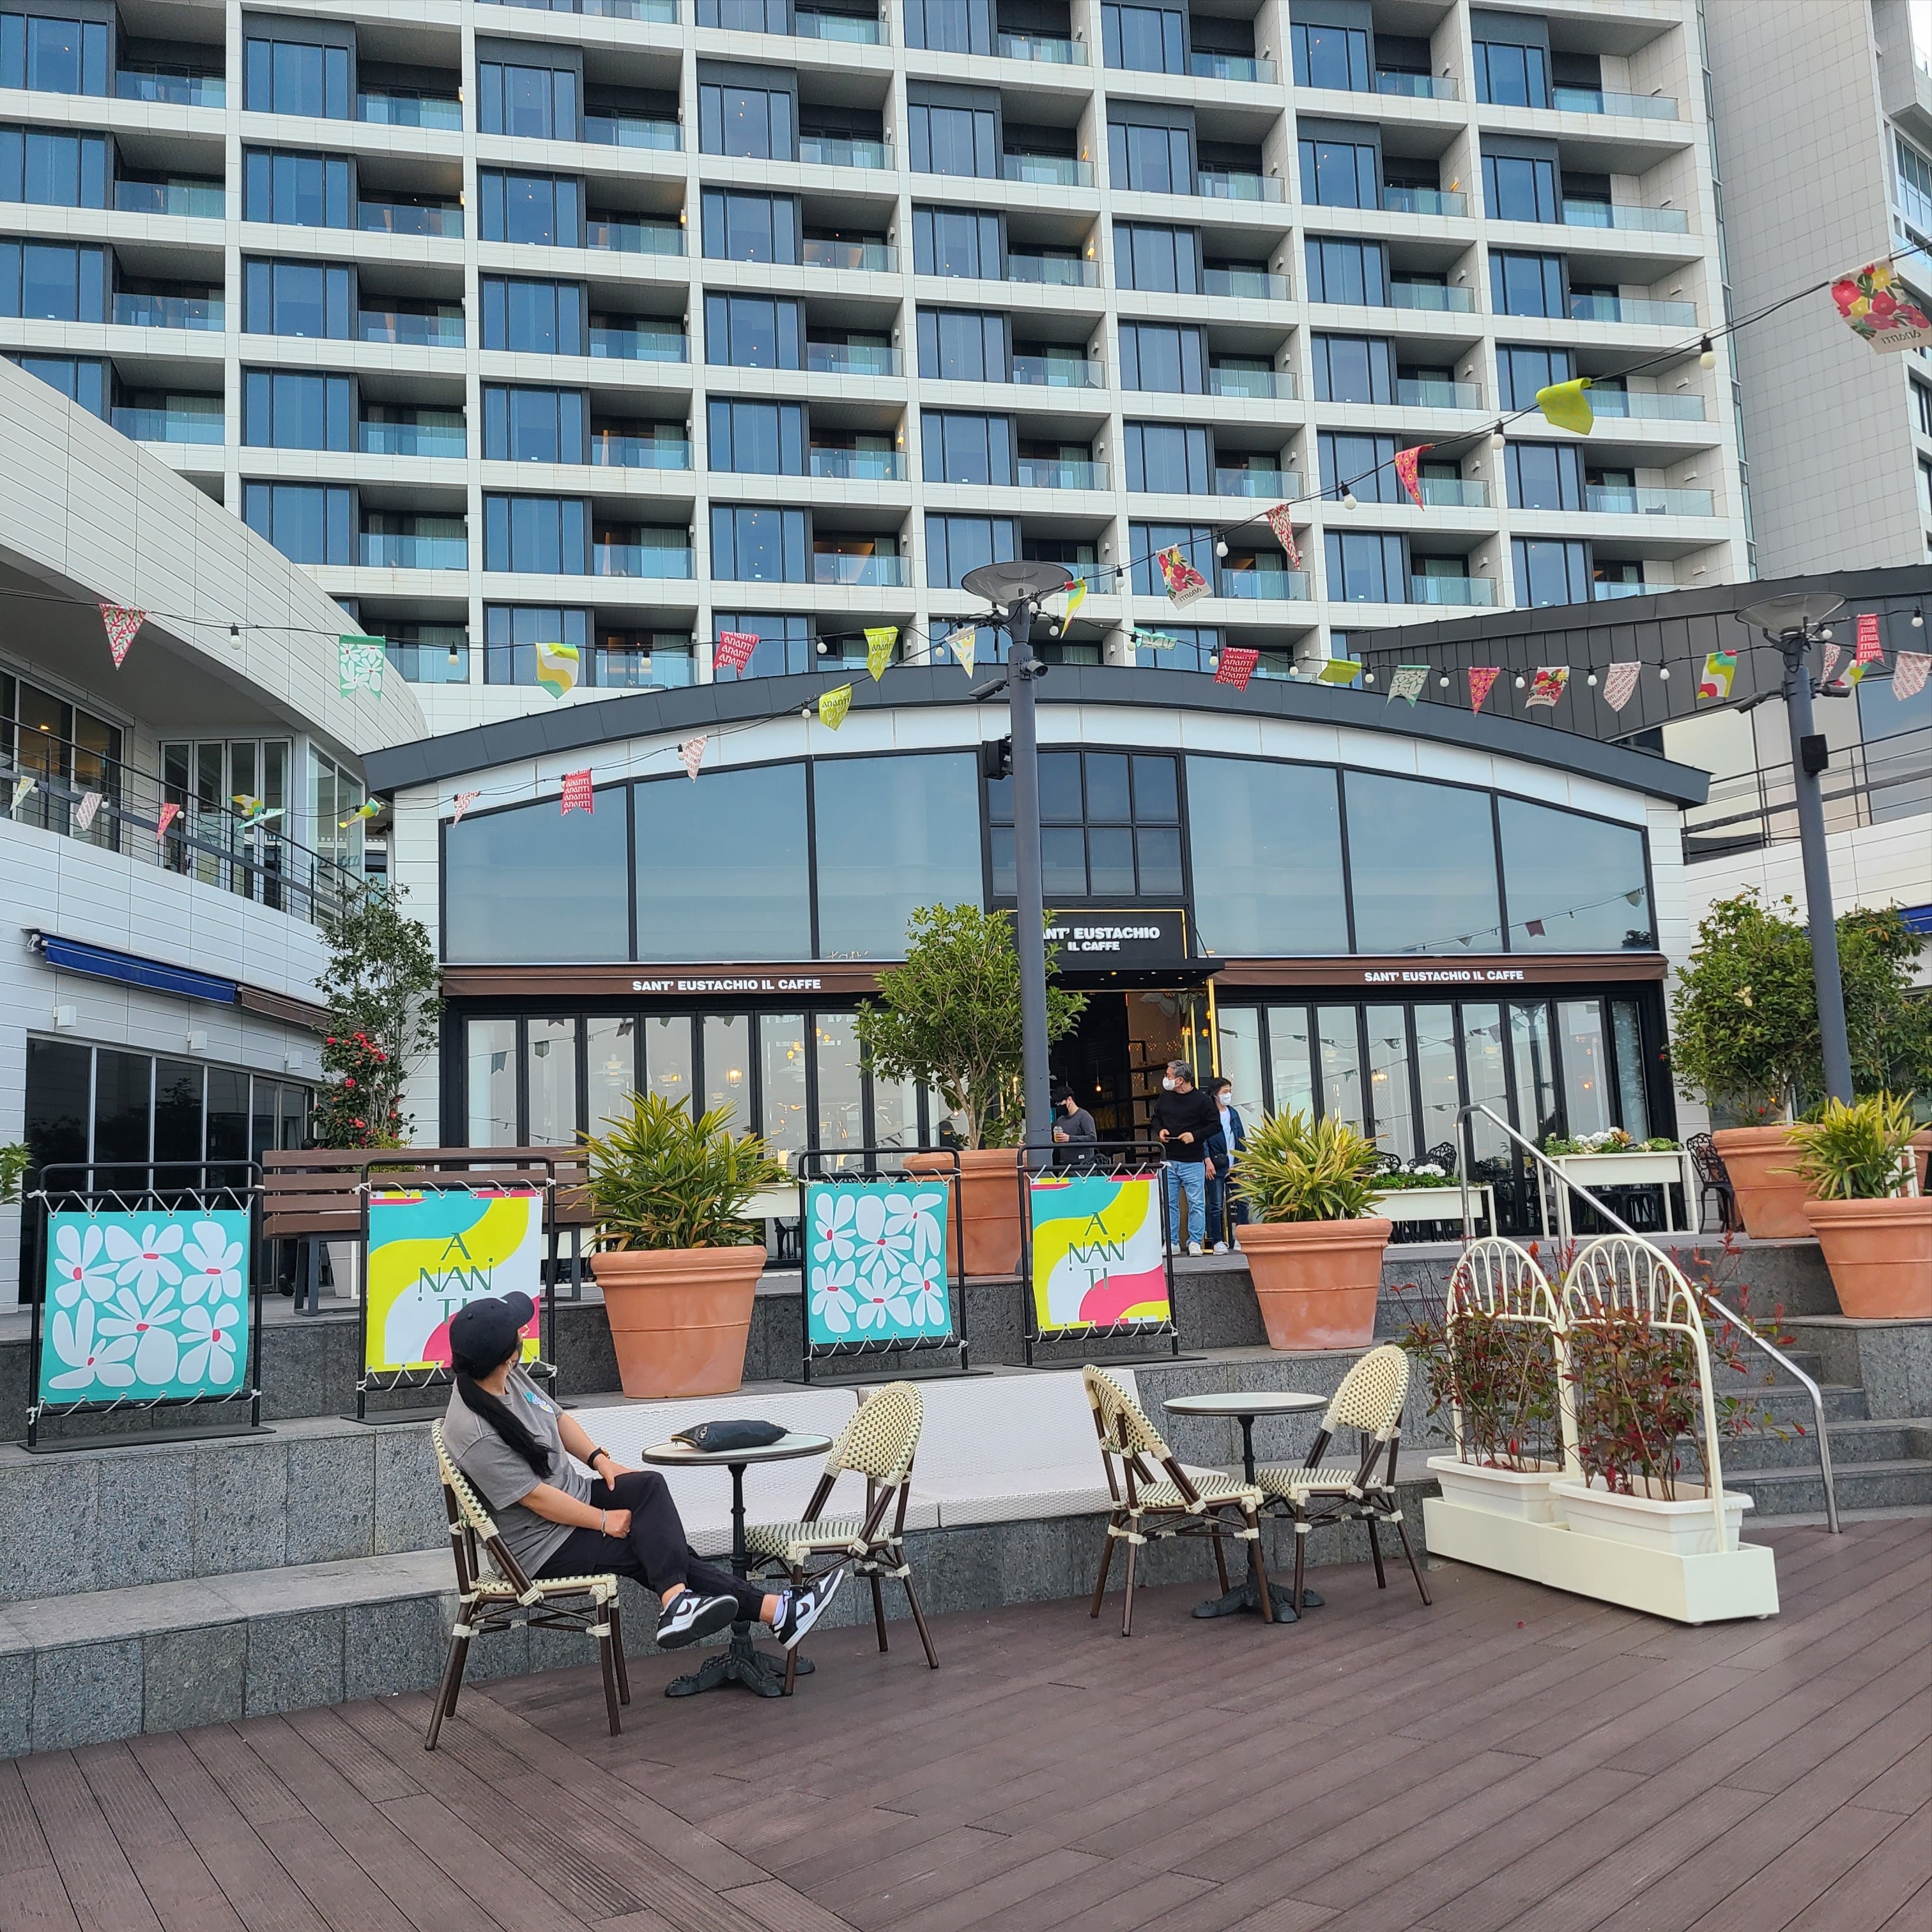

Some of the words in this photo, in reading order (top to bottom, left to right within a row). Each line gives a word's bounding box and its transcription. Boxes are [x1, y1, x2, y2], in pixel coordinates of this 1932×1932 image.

[1043, 927, 1070, 940] NT'
[1073, 926, 1160, 940] EUSTACHIO
[1067, 941, 1080, 952] IL
[1081, 940, 1121, 951] CAFFE
[1364, 972, 1400, 982] SANT'
[1402, 970, 1470, 981] EUSTACHIO
[1473, 971, 1485, 981] IL
[1487, 970, 1524, 981] CAFFE
[632, 980, 674, 991] SANT'
[677, 979, 758, 991] EUSTACHIO
[761, 979, 775, 990] IL
[778, 978, 822, 990] CAFFE
